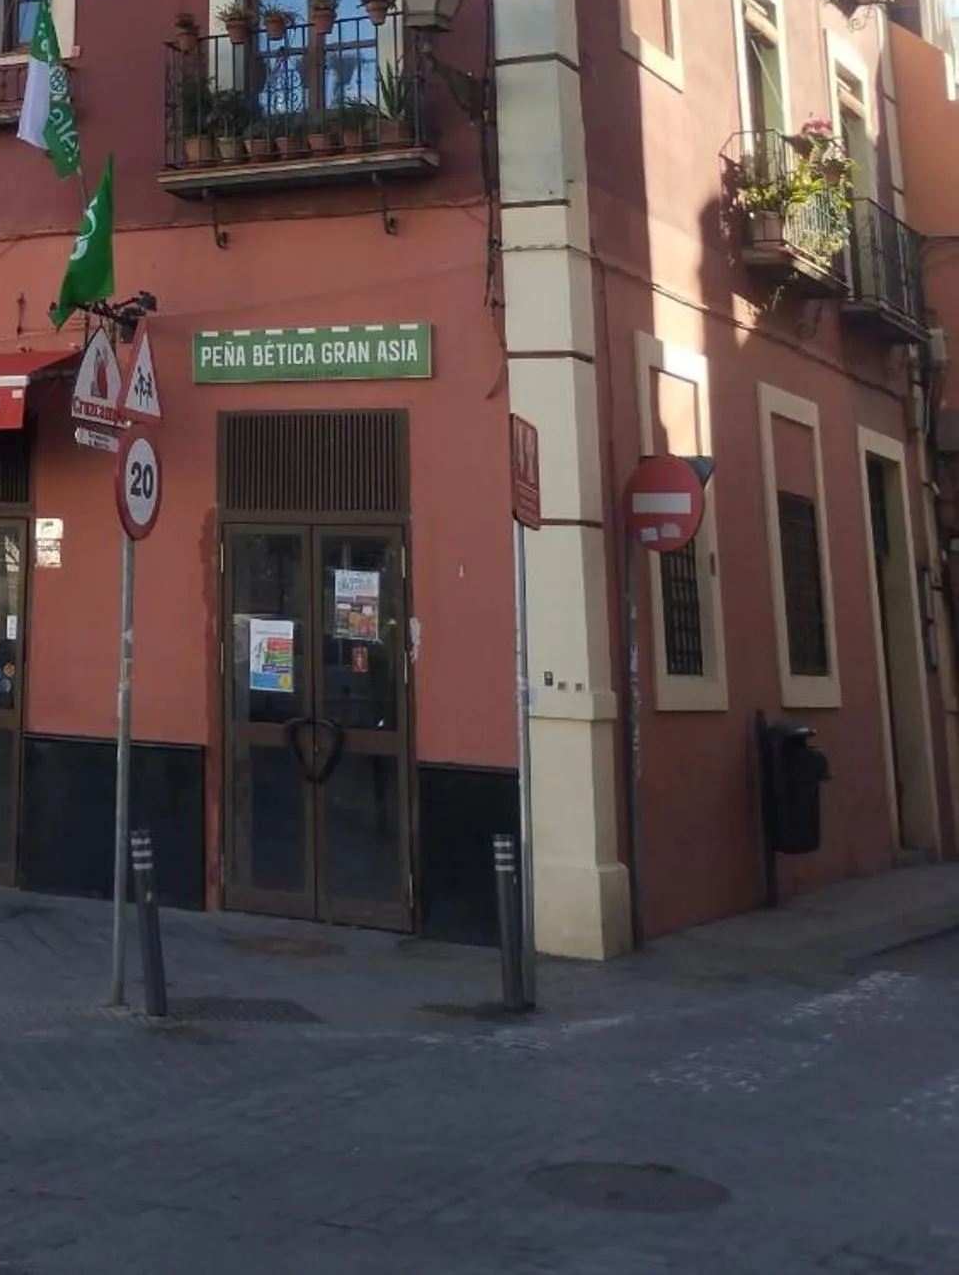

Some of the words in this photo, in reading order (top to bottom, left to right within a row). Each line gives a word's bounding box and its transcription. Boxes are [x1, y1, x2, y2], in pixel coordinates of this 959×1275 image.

[200, 341, 246, 368] PEÑA
[252, 340, 316, 367] BÉTICA
[321, 341, 371, 364] GRAN
[377, 339, 419, 362] ASIA
[130, 461, 154, 499] 20
